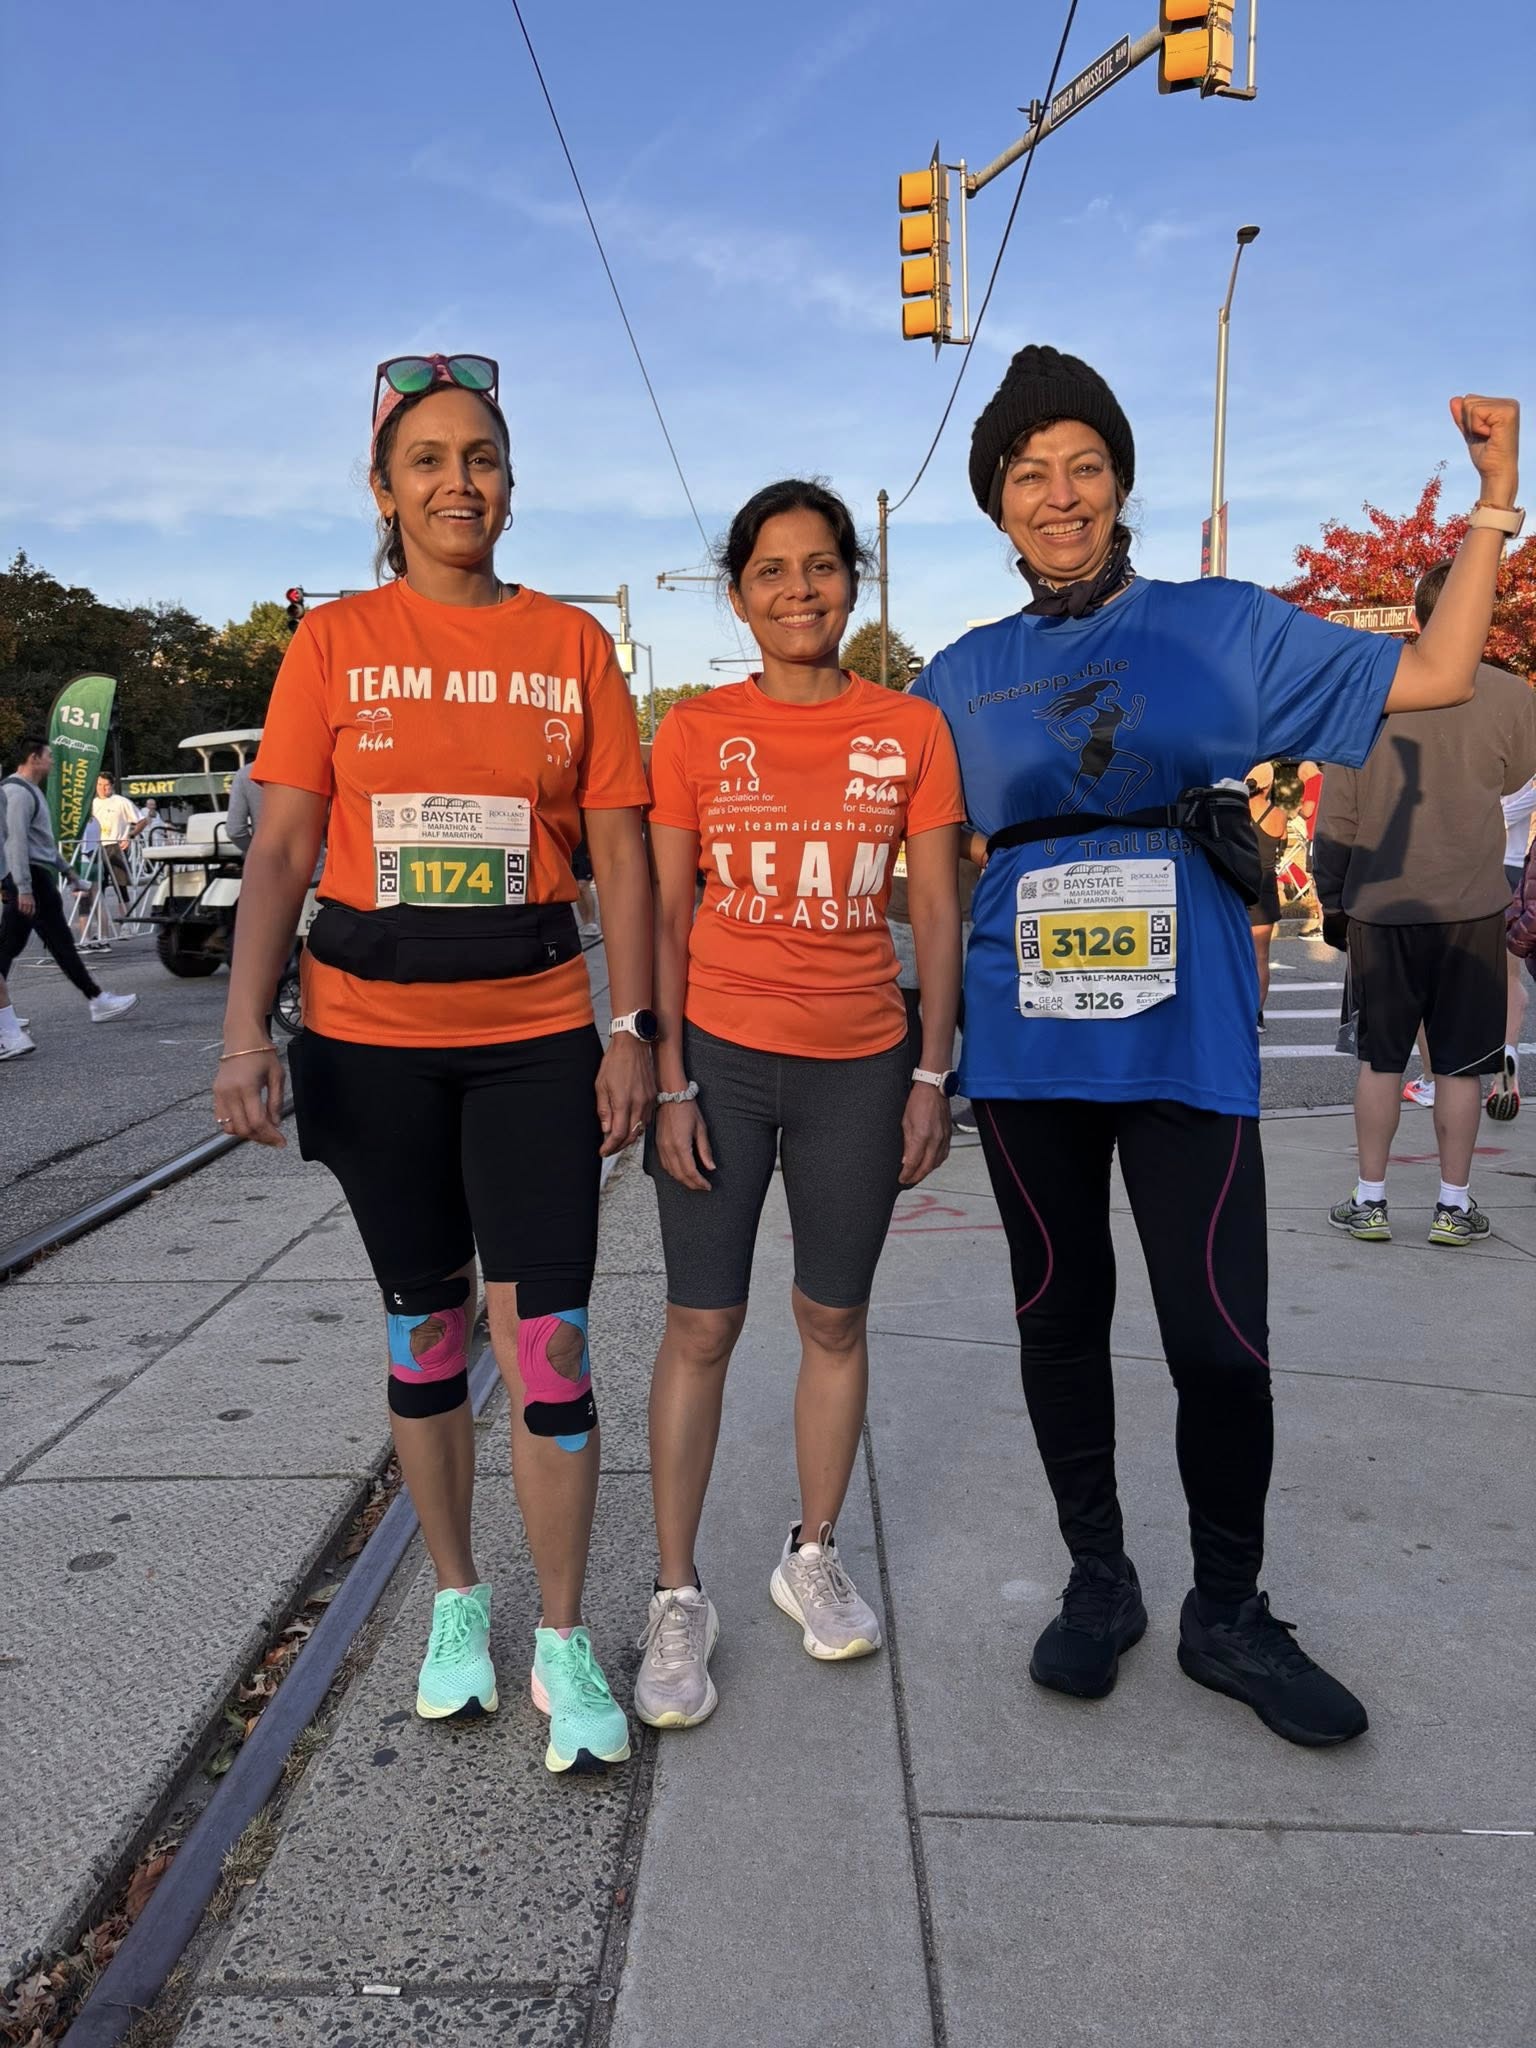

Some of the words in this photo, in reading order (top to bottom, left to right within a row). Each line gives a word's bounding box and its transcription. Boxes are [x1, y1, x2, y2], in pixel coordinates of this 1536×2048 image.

[1052, 88, 1073, 121] FATHER
[1075, 54, 1113, 102] MORISSETTE
[1354, 610, 1378, 629] Martin
[1381, 608, 1405, 627] Luther
[347, 665, 432, 703] TEAM
[444, 670, 497, 703] AID
[508, 671, 583, 714] ASHA
[967, 657, 1130, 715] Unstoppable
[59, 705, 101, 730] 13.1
[358, 733, 394, 752] Asha
[547, 753, 572, 769] aid
[129, 780, 176, 795] START
[719, 777, 760, 793] aid
[844, 777, 899, 804] Asha
[72, 758, 89, 837] MARATHON
[713, 793, 760, 803] Association
[762, 792, 775, 802] for
[421, 811, 483, 824] BAYSTATE
[728, 804, 788, 815] Development
[843, 803, 857, 813] for
[859, 804, 897, 816] Education
[422, 831, 440, 839] HALF
[442, 831, 484, 839] MARATHON
[427, 823, 468, 831] MARATHON
[708, 819, 896, 837] www.teamaidasha.org
[1079, 831, 1141, 858] Trail
[410, 861, 494, 894] 1174
[711, 841, 890, 898] TEAM
[1130, 873, 1170, 881] ROCKLAND
[1063, 876, 1124, 890] BAYSTATE
[1069, 889, 1109, 897] MARATHON
[1111, 888, 1118, 896] &
[1083, 896, 1124, 904] MARATHON
[716, 889, 877, 931] AID-ASHA
[1051, 925, 1136, 957] 3126
[1060, 975, 1075, 983] 13.1
[1081, 973, 1161, 983] HALF-MARATHON
[1033, 1003, 1065, 1011] CHECK
[1038, 996, 1064, 1004] GEAR
[1074, 992, 1124, 1011] 3126
